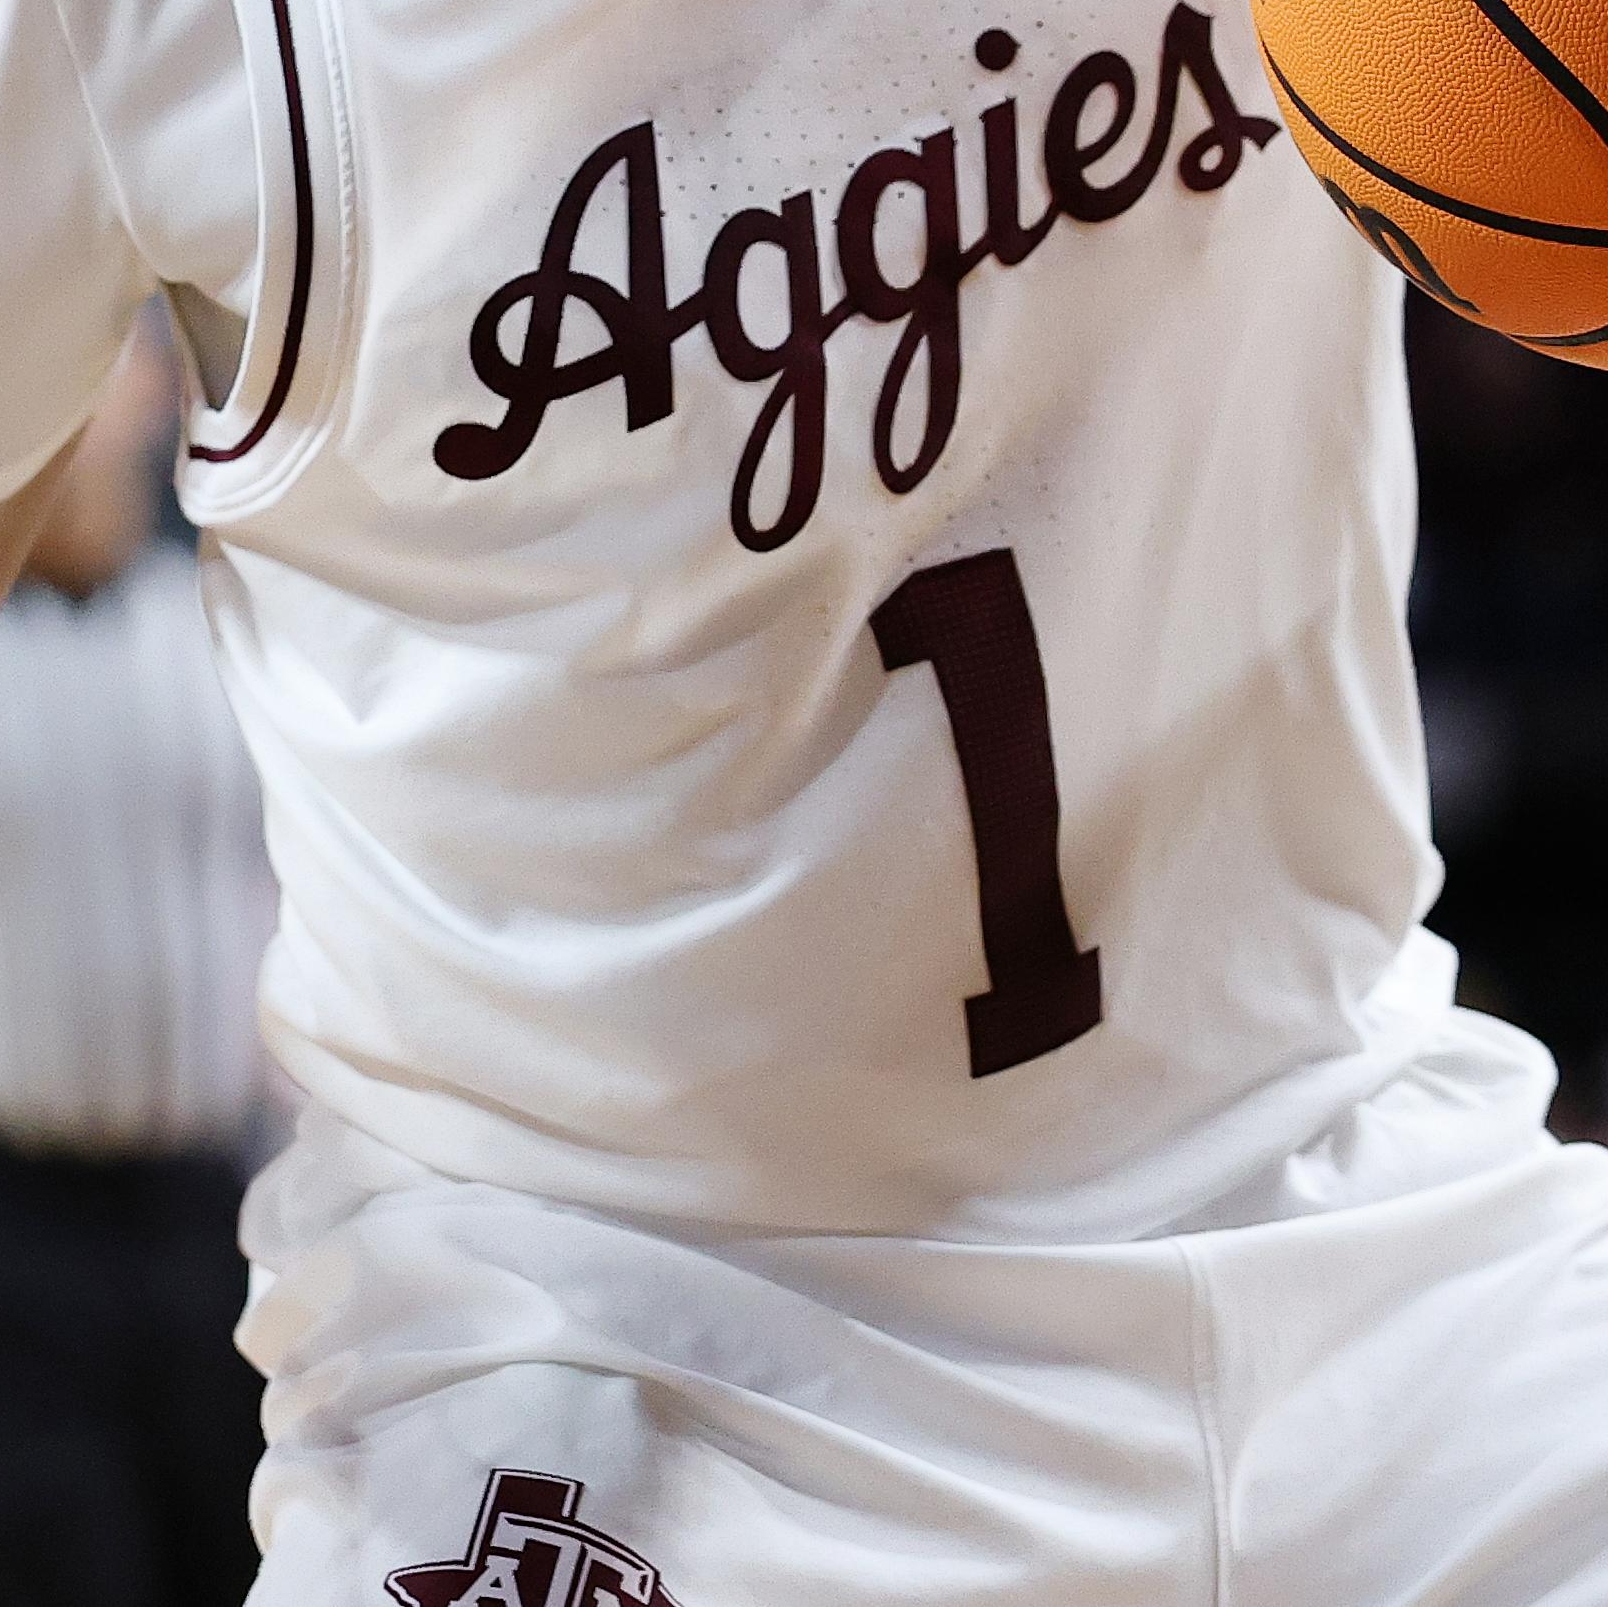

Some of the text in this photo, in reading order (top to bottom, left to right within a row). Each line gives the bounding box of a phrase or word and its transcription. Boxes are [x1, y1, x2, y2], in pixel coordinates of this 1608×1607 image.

[432, 0, 1282, 553] Aggies
[868, 547, 1103, 1080] 1
[445, 1511, 657, 1607] AT
